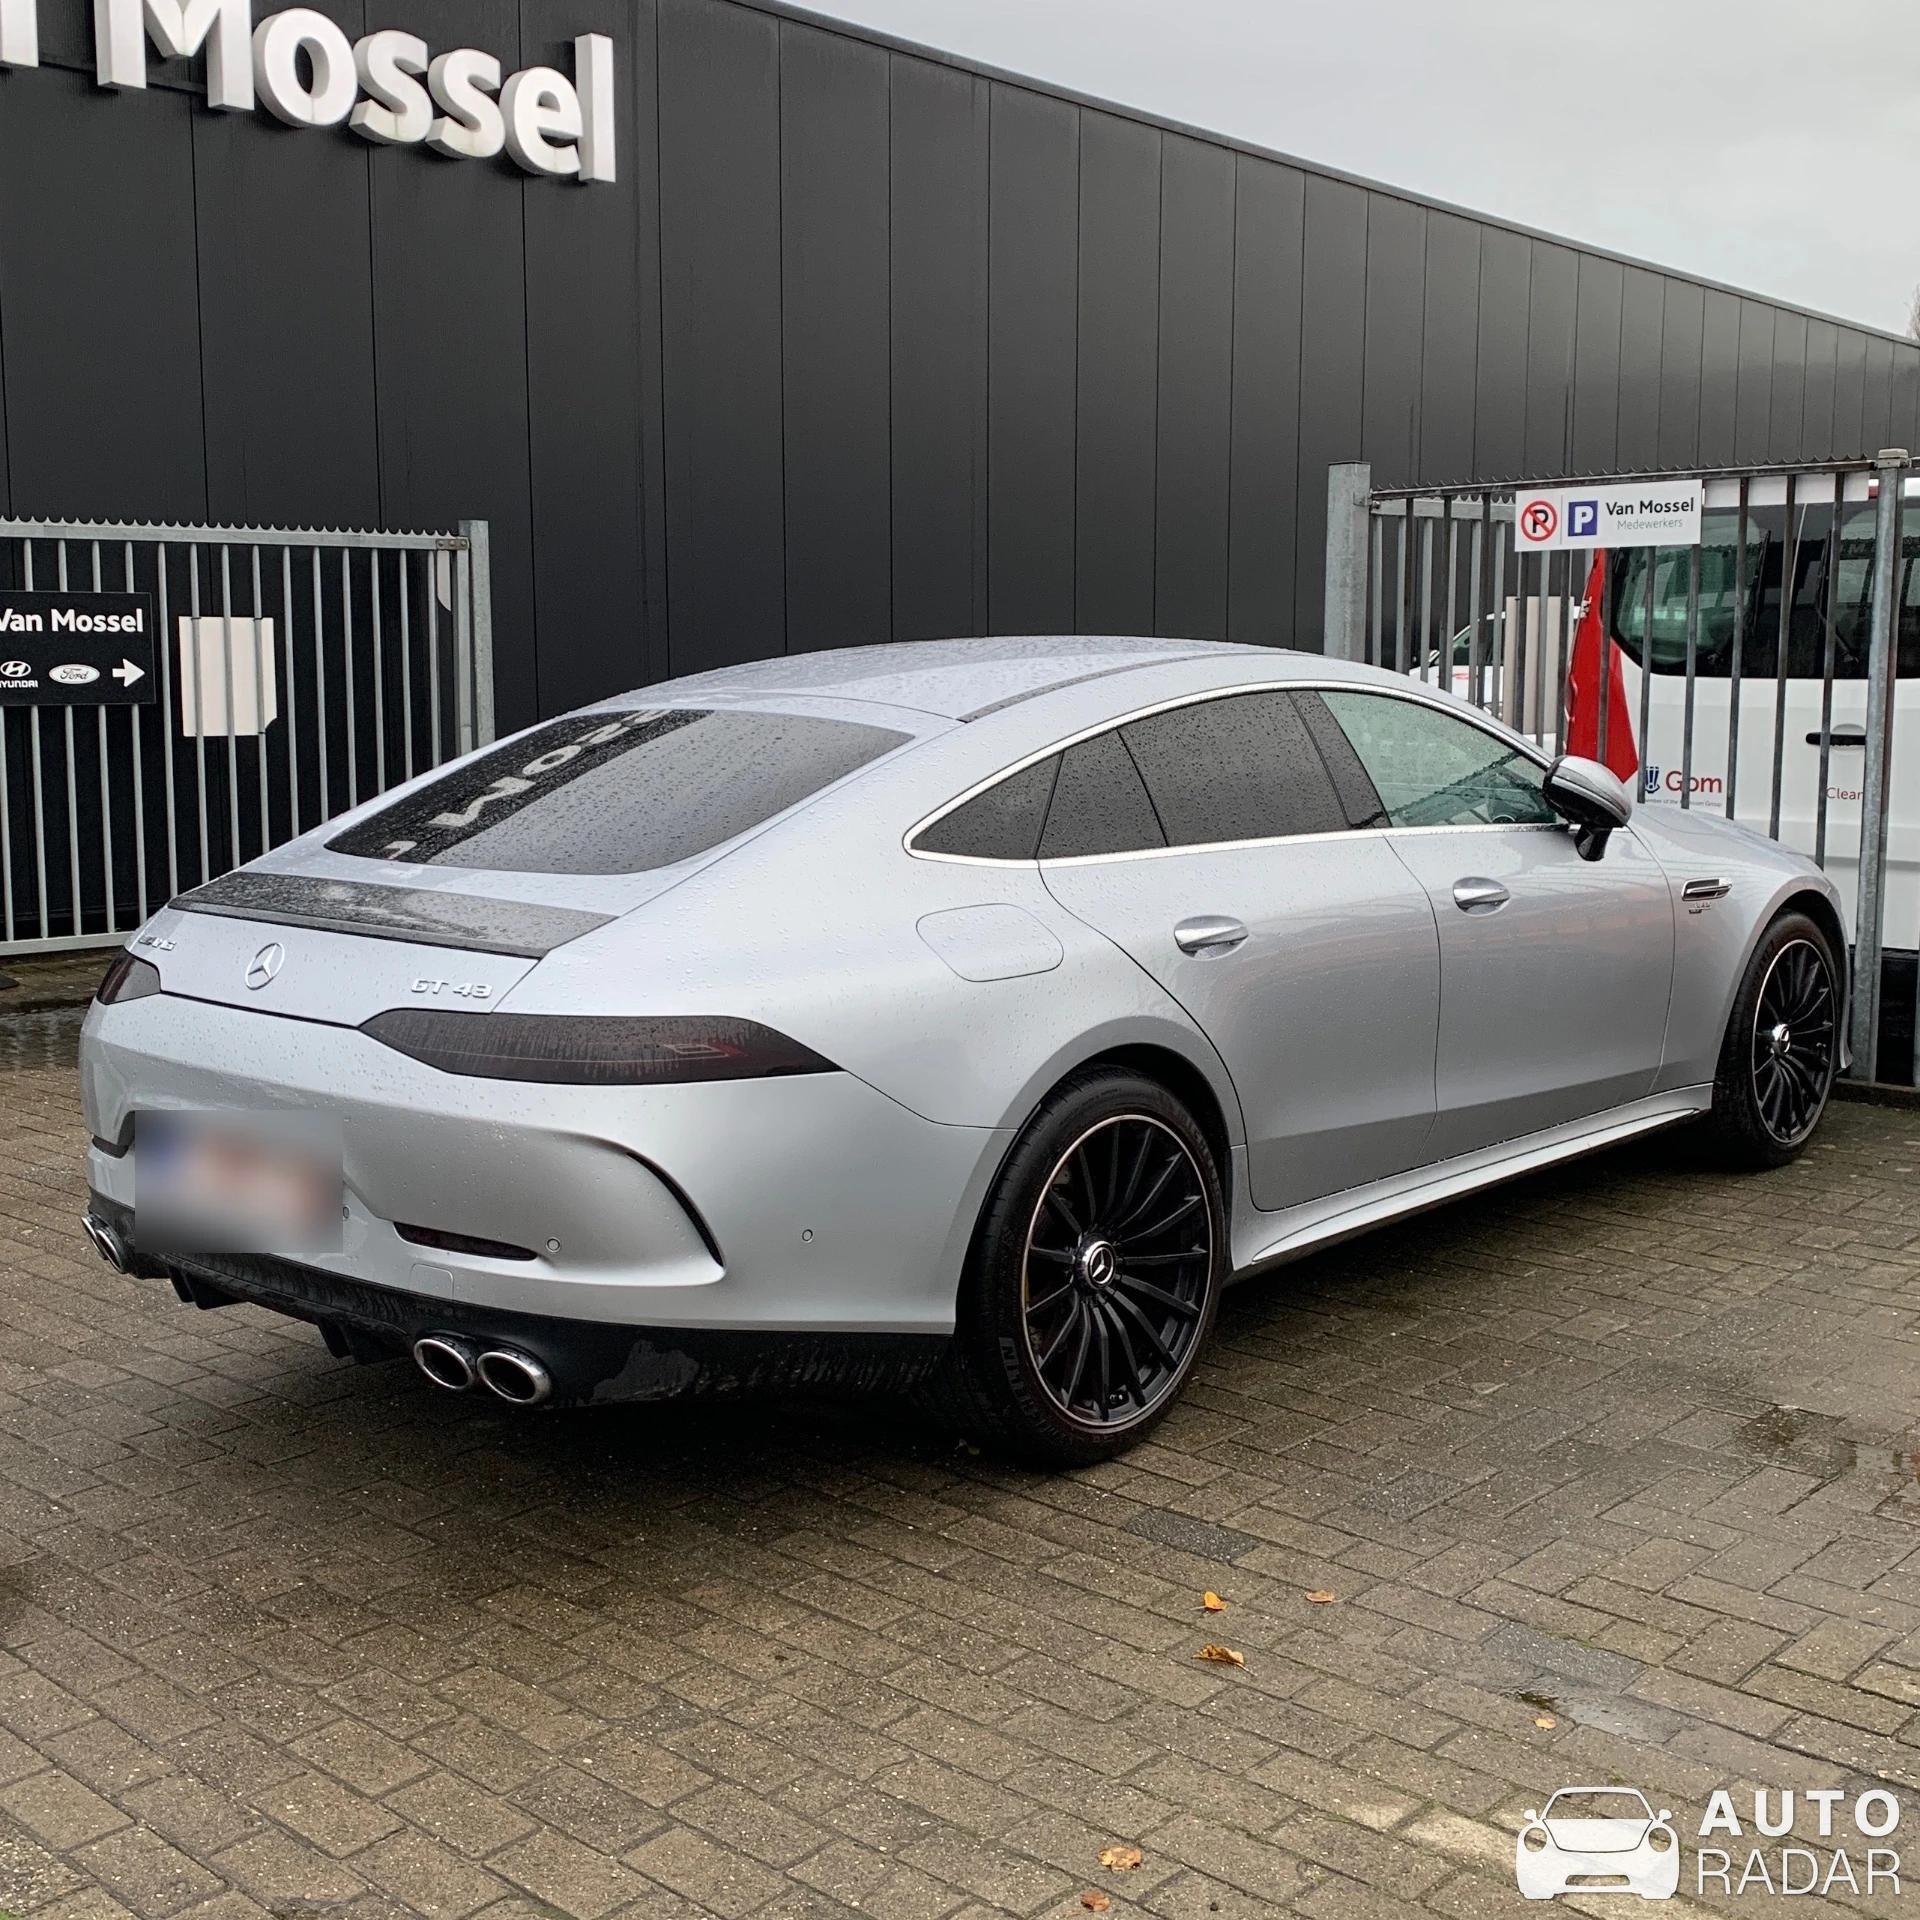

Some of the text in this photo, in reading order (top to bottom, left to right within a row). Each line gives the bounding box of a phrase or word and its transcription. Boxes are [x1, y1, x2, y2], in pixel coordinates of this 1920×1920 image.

[95, 0, 616, 183] Mossel
[1606, 496, 1695, 516] Van Mossel
[1617, 517, 1683, 531] Medewerkers
[0, 608, 144, 632] Van Mossel
[60, 667, 90, 680] Ford
[0, 680, 39, 689] YUNDAI
[1665, 770, 1722, 793] Gom
[410, 978, 449, 995] GT
